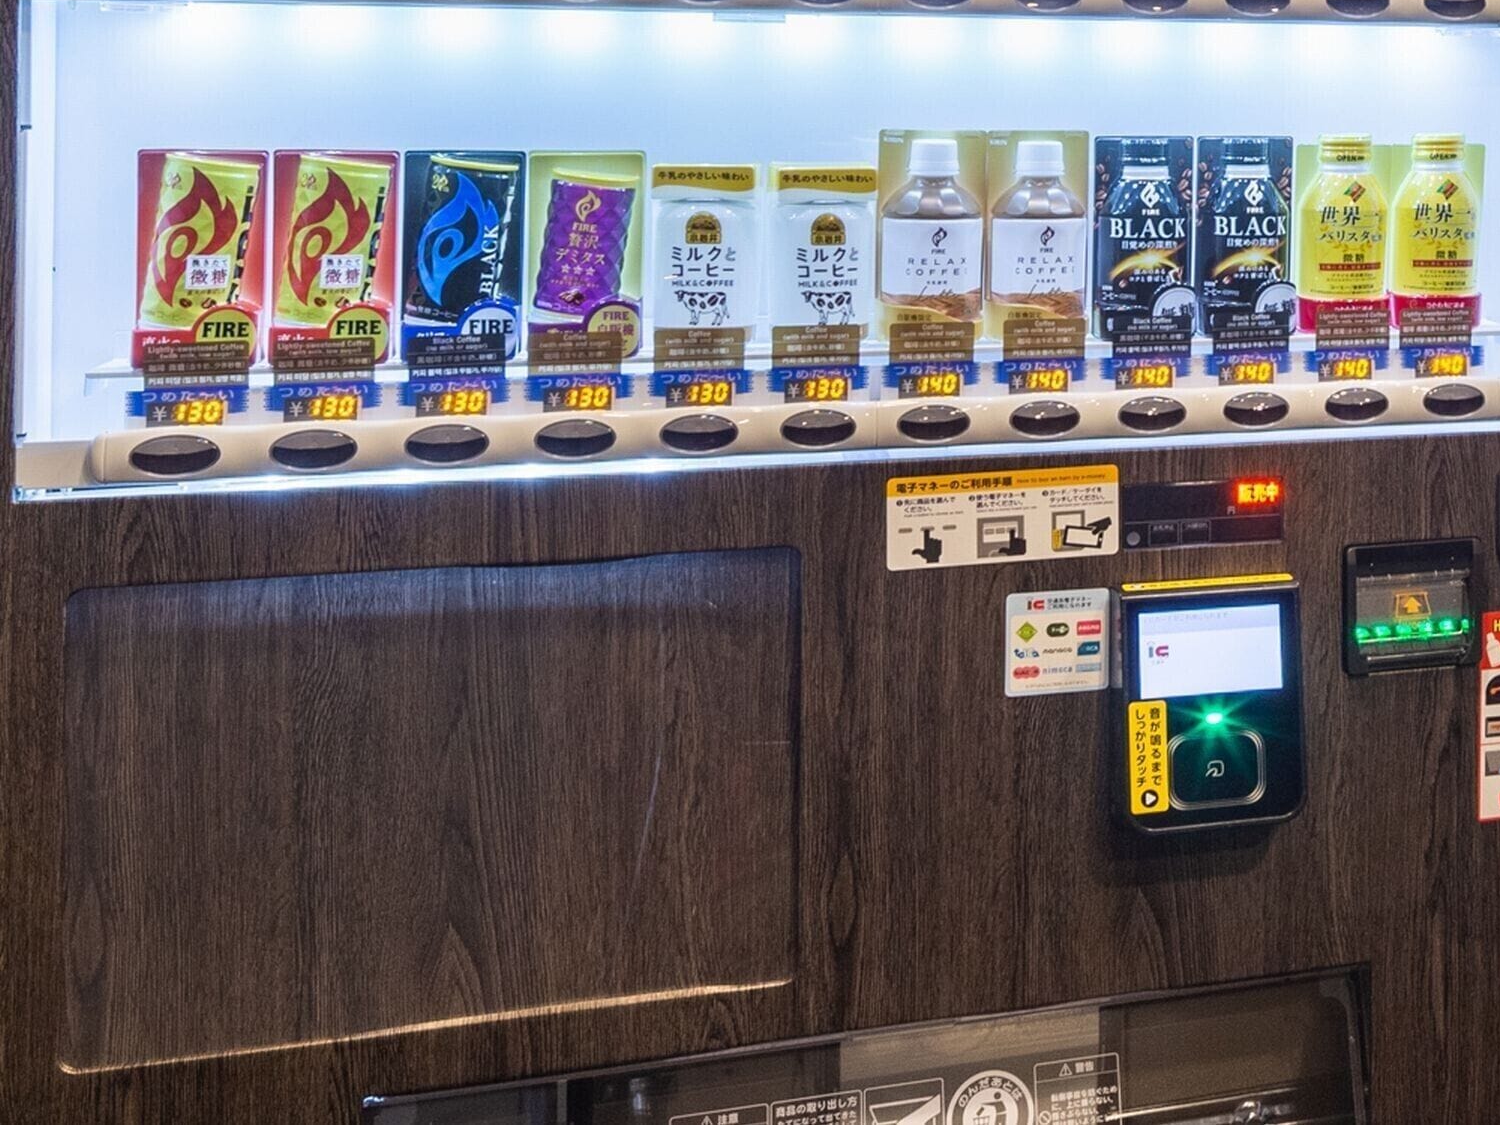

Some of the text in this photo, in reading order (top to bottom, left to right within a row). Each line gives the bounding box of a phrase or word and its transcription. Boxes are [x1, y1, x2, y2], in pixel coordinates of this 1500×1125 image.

[657, 171, 750, 182] 牛乳のやさしい味わい
[1110, 219, 1186, 239] BLACK
[479, 225, 499, 295] BLACK
[671, 246, 737, 262] ミルクと
[797, 247, 859, 263] ミルクと
[190, 267, 227, 285] 微糖
[671, 264, 735, 277] コーヒー
[202, 322, 250, 338] FIRE
[336, 319, 382, 336] FIRE
[917, 374, 956, 393] 140
[1027, 371, 1065, 390] 140
[1237, 483, 1279, 504] 販売中
[1135, 710, 1146, 787] しっかりタッチ
[1150, 708, 1162, 786] 音が鳴るまで
[958, 1077, 1023, 1108] のんだあとは
